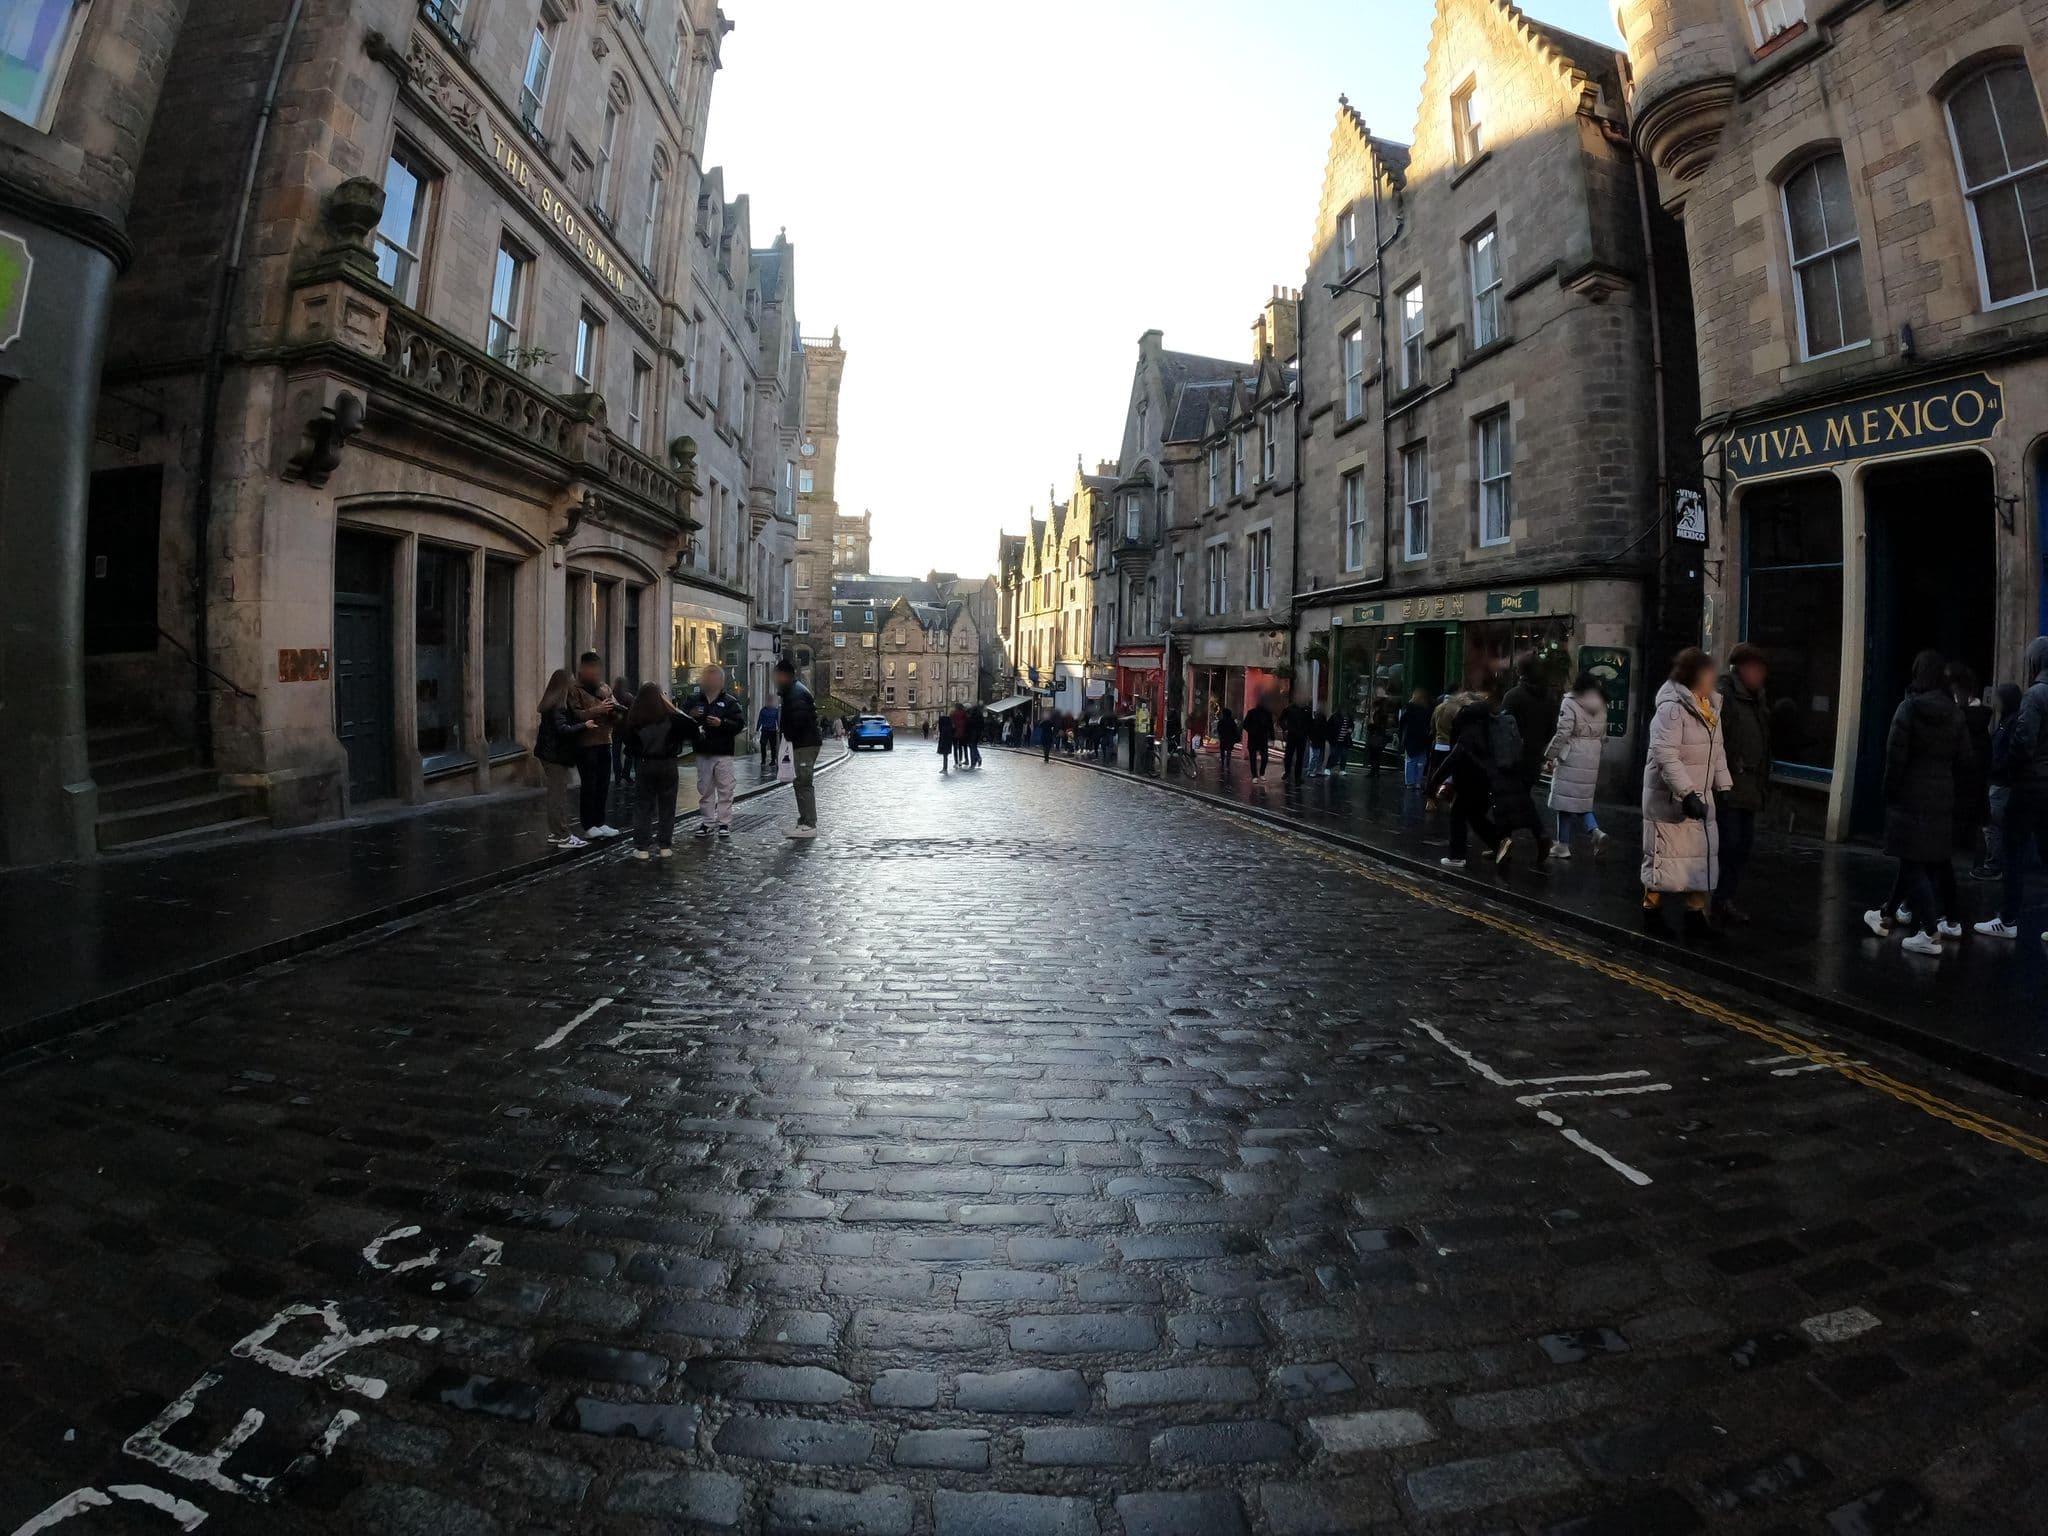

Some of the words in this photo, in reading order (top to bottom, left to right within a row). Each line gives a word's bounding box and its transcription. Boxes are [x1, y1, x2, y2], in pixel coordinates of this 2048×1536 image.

[494, 133, 529, 187] THE
[541, 187, 624, 291] SCOTSMAN
[1737, 425, 1813, 466] VIVA
[1823, 389, 1985, 451] MEXICO
[1987, 398, 1998, 409] 41
[1679, 488, 1699, 500] VIVA
[1676, 529, 1706, 541] MEXICO
[1402, 594, 1464, 618] EDEN
[1501, 597, 1523, 609] HOME
